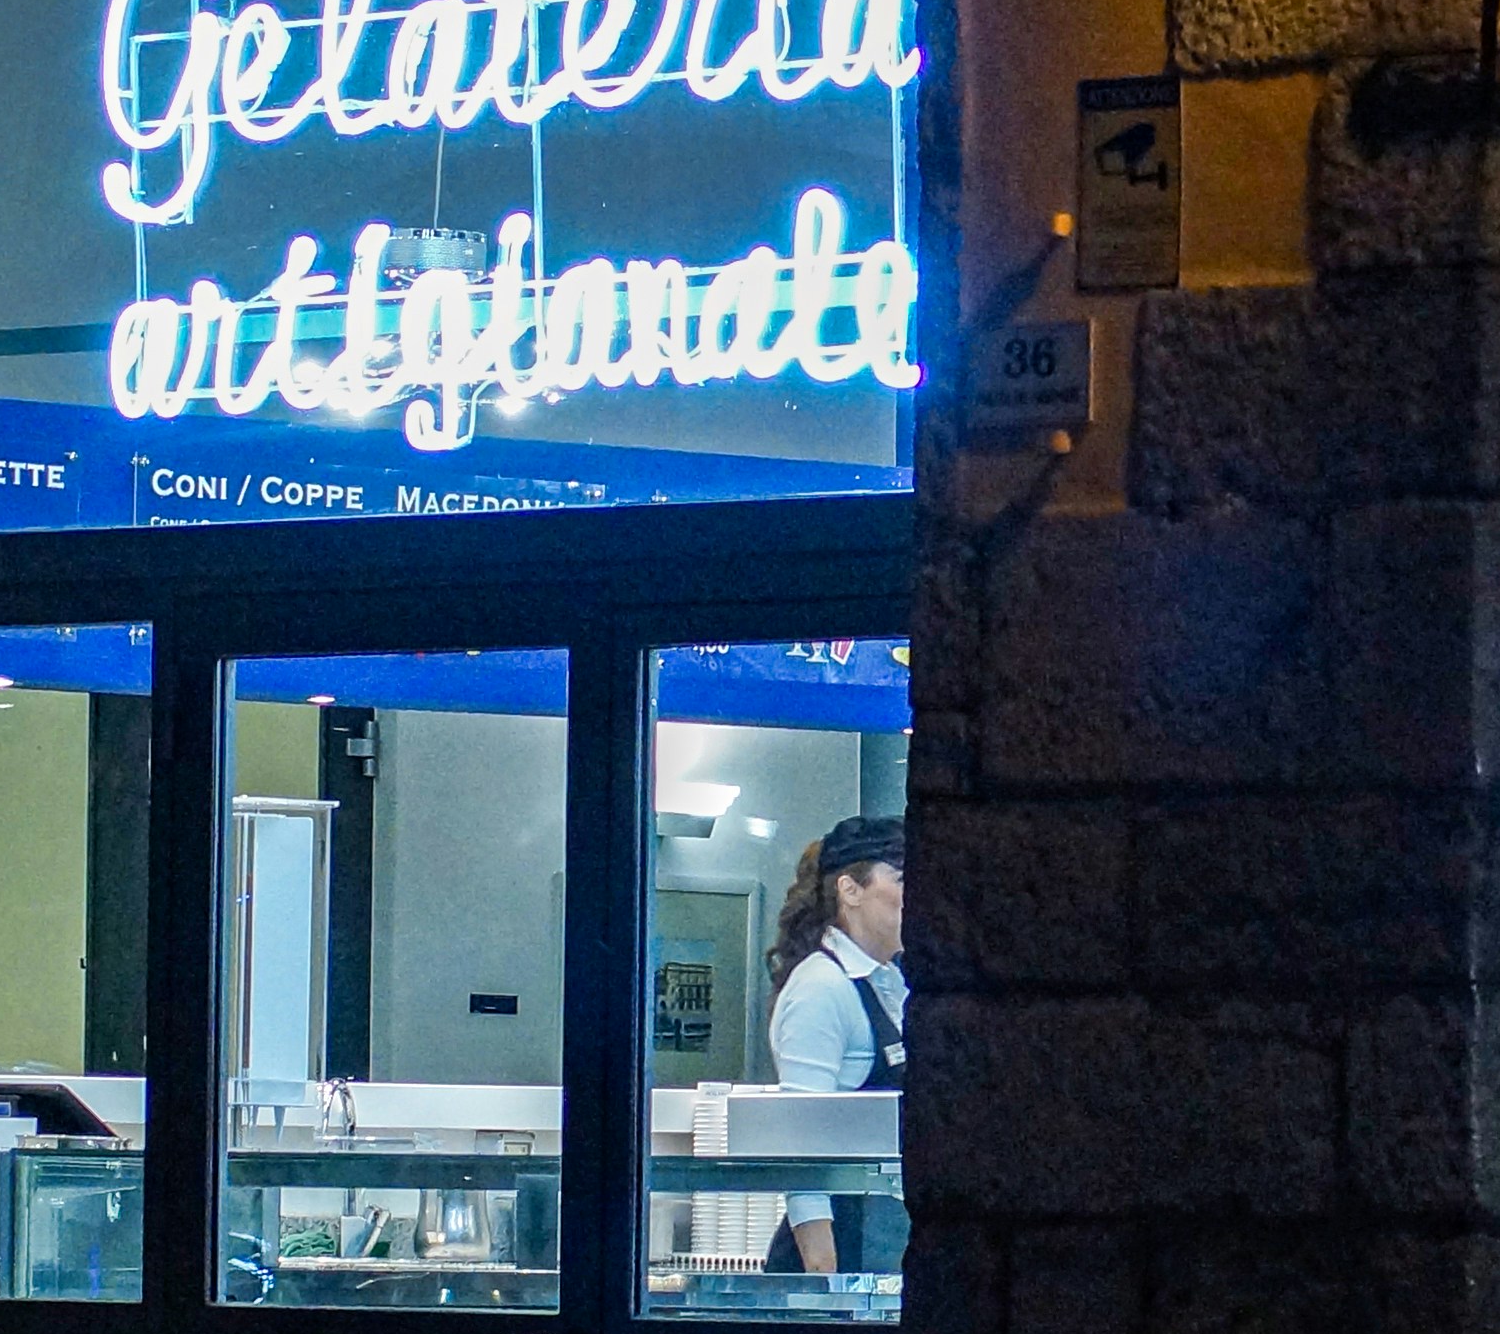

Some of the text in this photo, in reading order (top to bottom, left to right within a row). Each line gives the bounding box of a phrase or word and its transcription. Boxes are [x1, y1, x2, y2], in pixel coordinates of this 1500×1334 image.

[110, 187, 923, 450] artigianale
[1003, 337, 1056, 379] 36
[151, 468, 228, 500] CONI
[260, 476, 364, 510] COPPE
